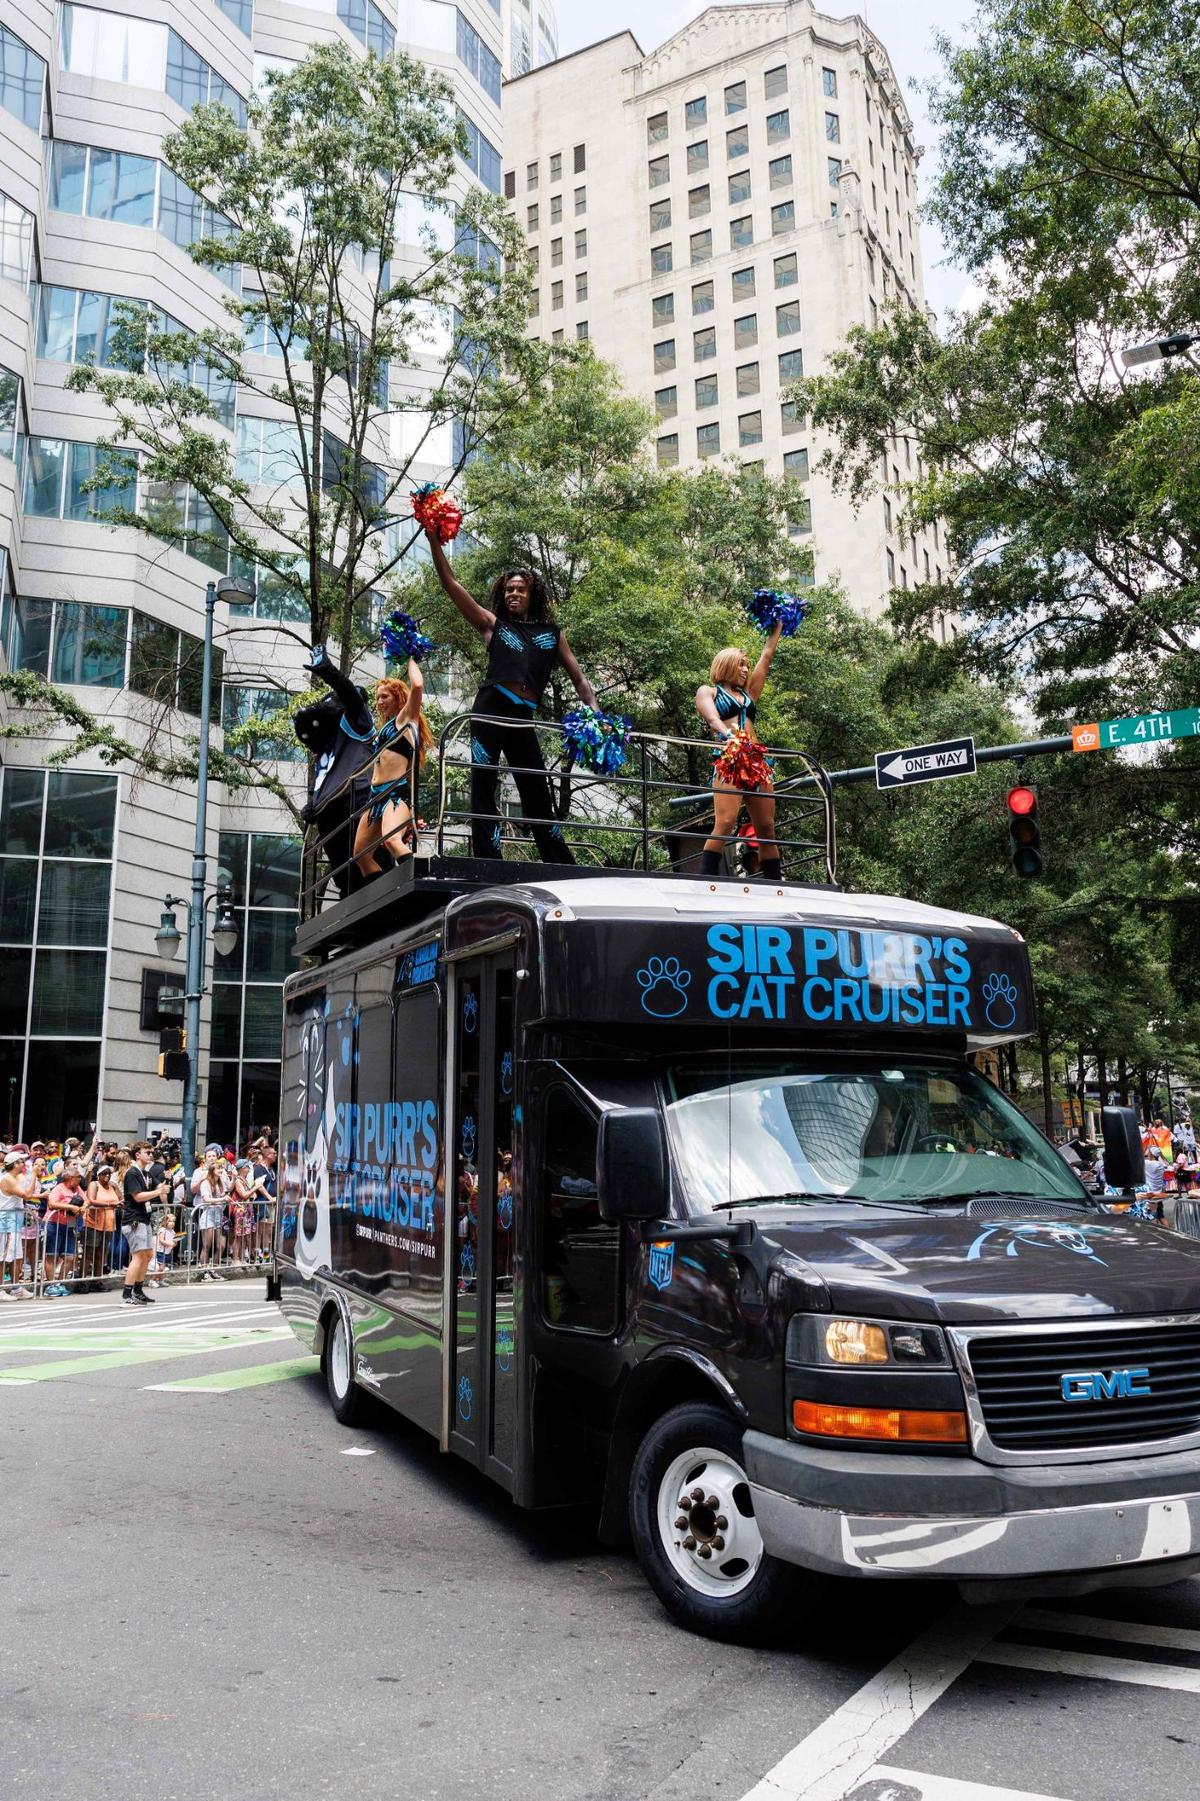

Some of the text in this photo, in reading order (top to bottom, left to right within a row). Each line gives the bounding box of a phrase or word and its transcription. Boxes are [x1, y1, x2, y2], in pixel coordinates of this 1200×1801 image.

[1109, 716, 1172, 743] E. 4TH
[905, 751, 963, 772] ONE WAY
[706, 923, 971, 984] SIR PURR'S
[707, 973, 972, 1026] CAT CRUISER
[335, 1100, 437, 1169] SIR PURR'S
[362, 1163, 436, 1233] CRUISER
[651, 1251, 672, 1282] NFL
[1061, 1368, 1152, 1401] GMC
